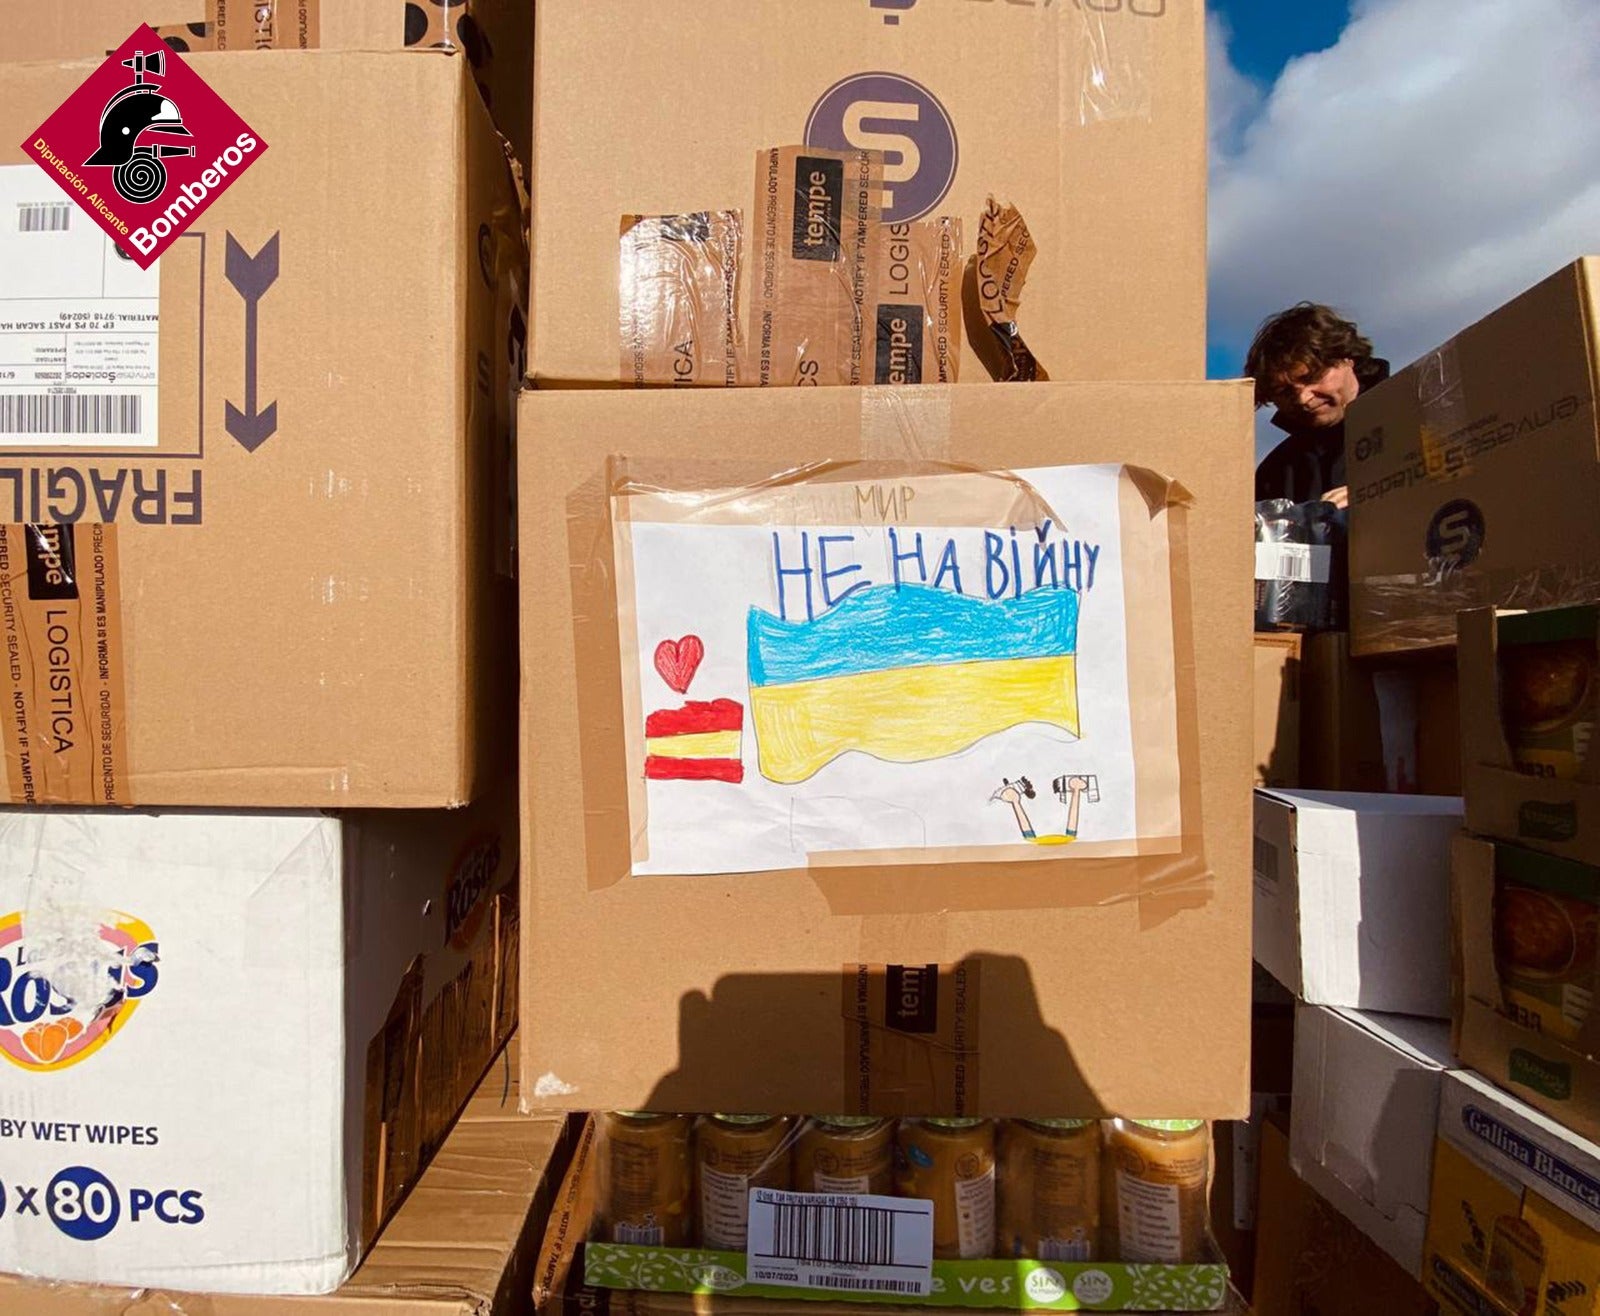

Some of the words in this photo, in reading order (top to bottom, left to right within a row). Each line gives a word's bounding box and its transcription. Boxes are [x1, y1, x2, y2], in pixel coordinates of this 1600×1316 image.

[766, 195, 777, 236] PRECINTO
[803, 171, 831, 246] tempe
[856, 191, 868, 250] TAMPERED
[856, 251, 865, 263] IF
[940, 235, 950, 277] SEALED
[854, 265, 866, 305] NOTIFY
[16, 322, 45, 330] SACAR
[59, 312, 91, 321] (50249)
[939, 279, 949, 333] SECURITY
[762, 310, 772, 348] INFORMA
[760, 360, 769, 371] ES
[761, 350, 770, 358] SI
[94, 555, 106, 613] MANIPULADO
[771, 531, 873, 623] НЕ
[888, 526, 965, 597] НА
[0, 573, 16, 632] SECURITY
[97, 615, 106, 627] ES
[97, 629, 106, 638] SI
[7, 635, 22, 680] SEALED
[97, 640, 109, 679] INFORMA
[46, 609, 74, 754] LOGISTICA
[13, 691, 27, 734] NOTIFY
[100, 690, 111, 741] SEGURIDAD
[19, 737, 28, 748] IF
[102, 743, 112, 755] DE
[103, 757, 115, 800] PRECINTO
[31, 1121, 81, 1142] WET
[86, 1124, 159, 1145] WIPES
[1468, 1110, 1531, 1168] Gallina
[53, 1179, 113, 1224] 80
[130, 1189, 205, 1224] PCS
[958, 1275, 1014, 1294] ves
[1031, 1275, 1059, 1287] SIN
[1080, 1275, 1108, 1286] SIN
